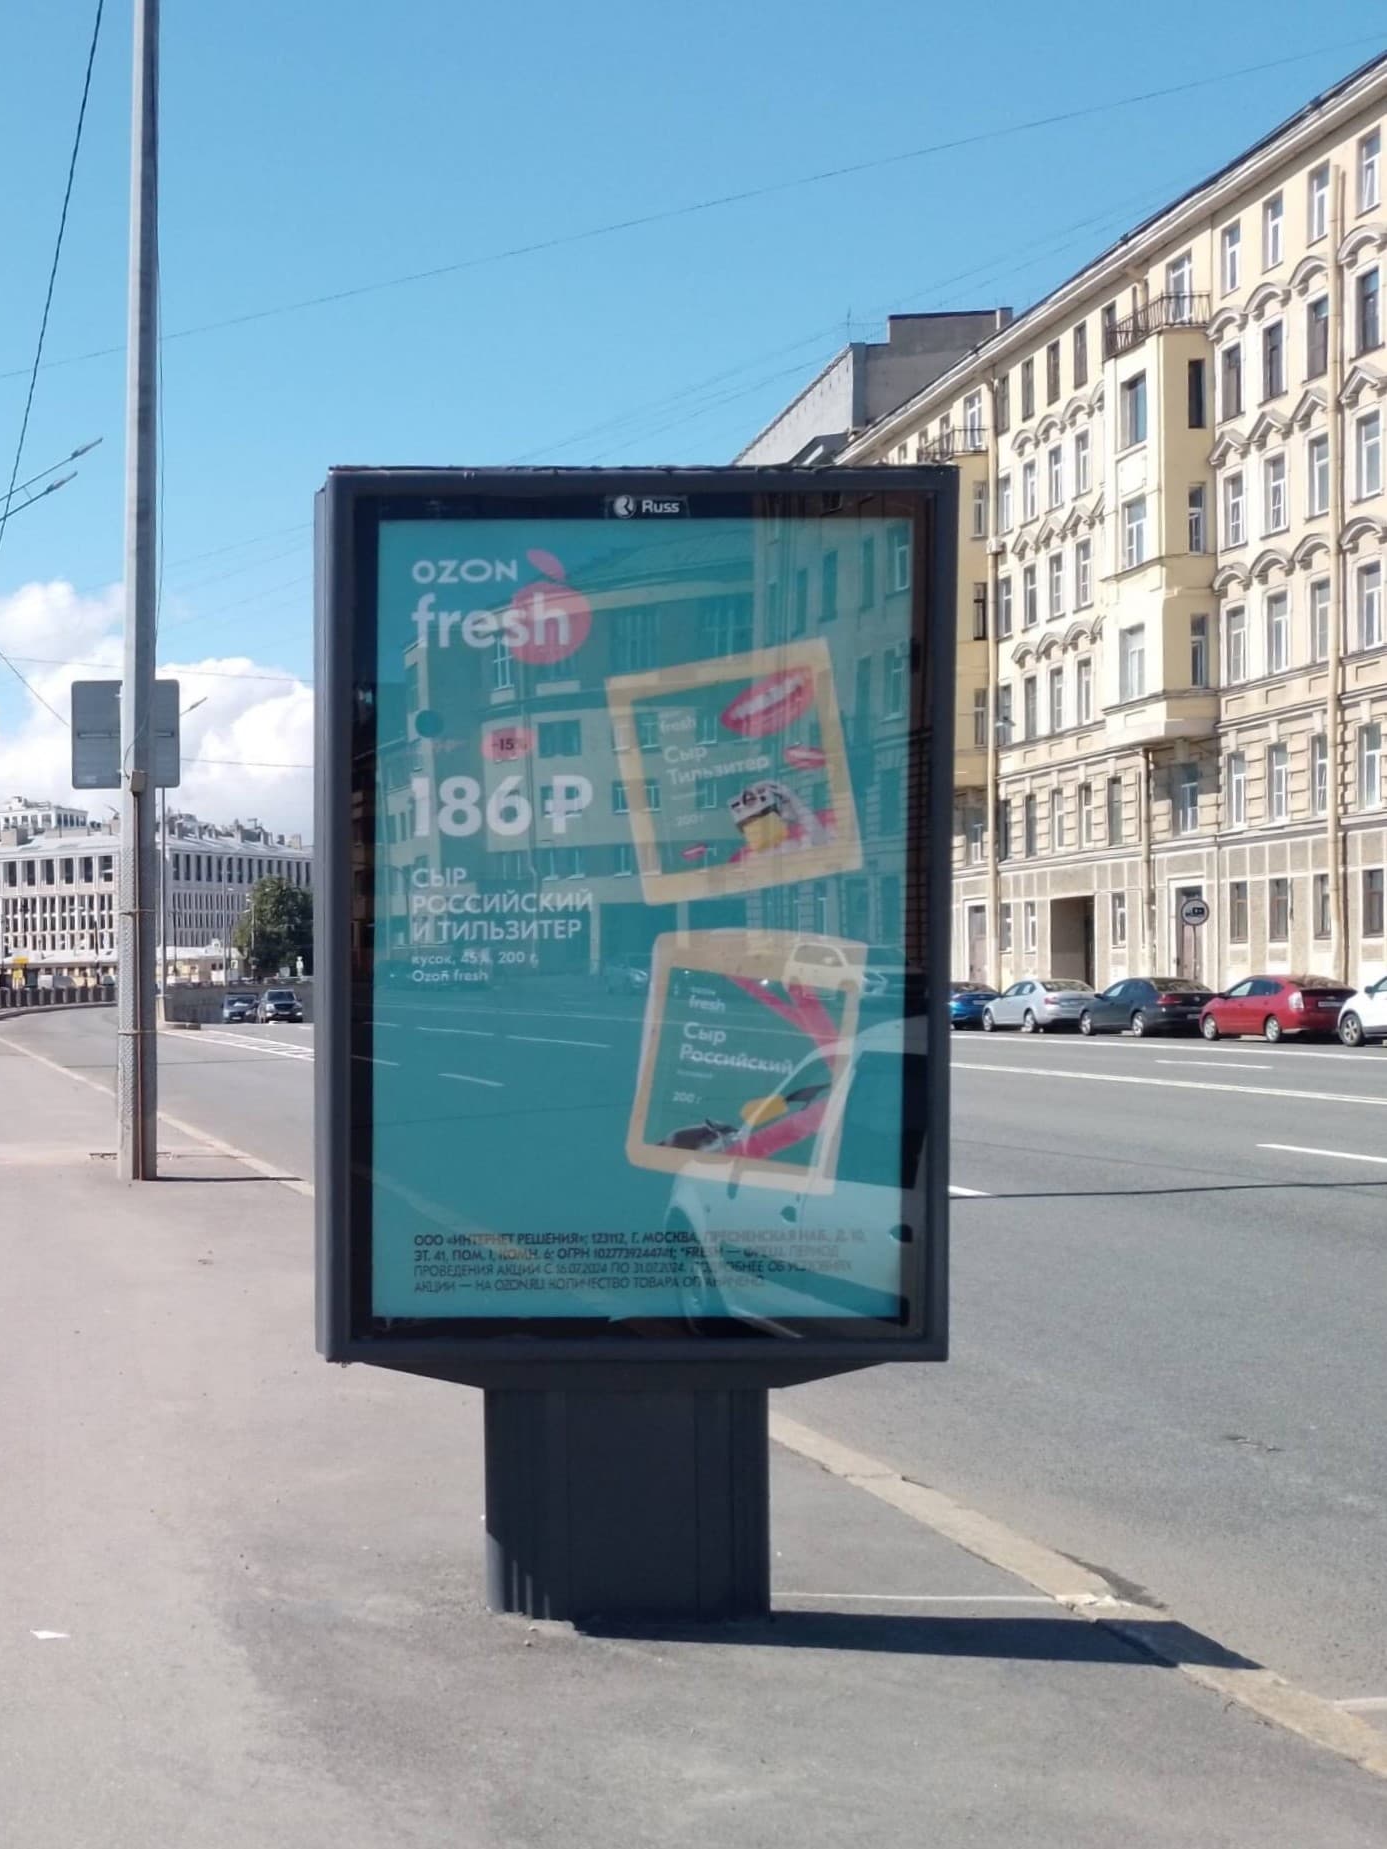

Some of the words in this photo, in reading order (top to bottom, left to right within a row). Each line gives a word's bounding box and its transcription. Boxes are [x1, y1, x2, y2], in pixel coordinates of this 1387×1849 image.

[642, 499, 680, 513] Russ
[412, 559, 518, 584] OZON
[411, 592, 569, 649] fresh
[664, 745, 708, 764] Сыр
[411, 867, 467, 888] СЫР
[412, 888, 594, 914] РОССИЙСКИЙ
[412, 920, 430, 941] И
[437, 919, 582, 941] ТИЛЬЗИТЕР
[683, 1021, 727, 1046] Сыр
[679, 1044, 794, 1075] Российский
[414, 1233, 444, 1246] ООО
